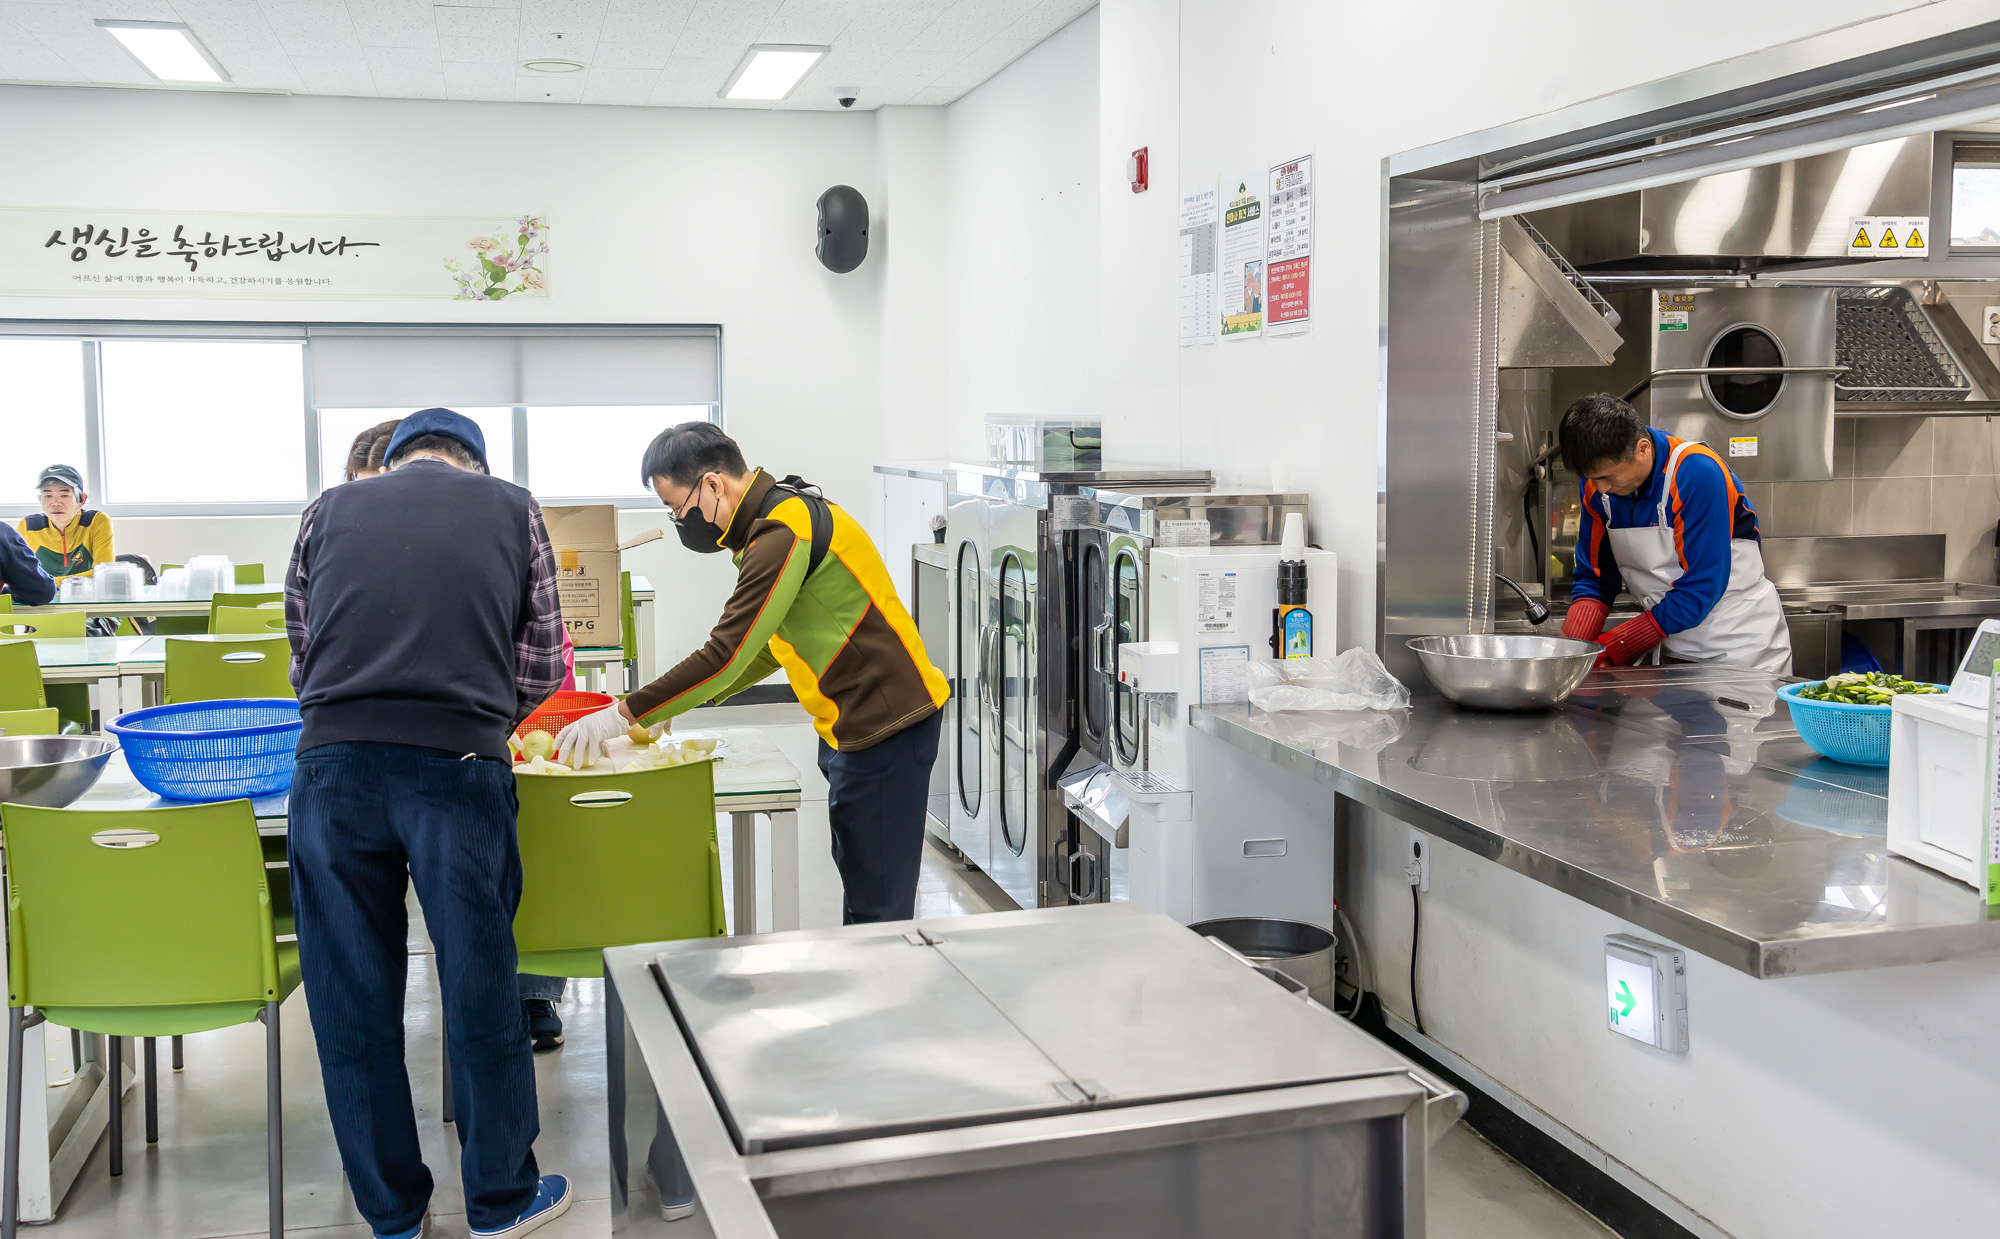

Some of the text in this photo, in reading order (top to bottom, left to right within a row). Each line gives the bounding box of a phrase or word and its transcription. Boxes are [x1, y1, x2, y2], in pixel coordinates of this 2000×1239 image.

[1247, 204, 1260, 217] 서비스
[44, 224, 380, 272] 생신을 축하드립니다.
[72, 274, 333, 286] 어르신 삶에 기쁨과 행복이 가득하고, 건강하시기를 응원합니다.
[1659, 301, 1695, 311] Solomon
